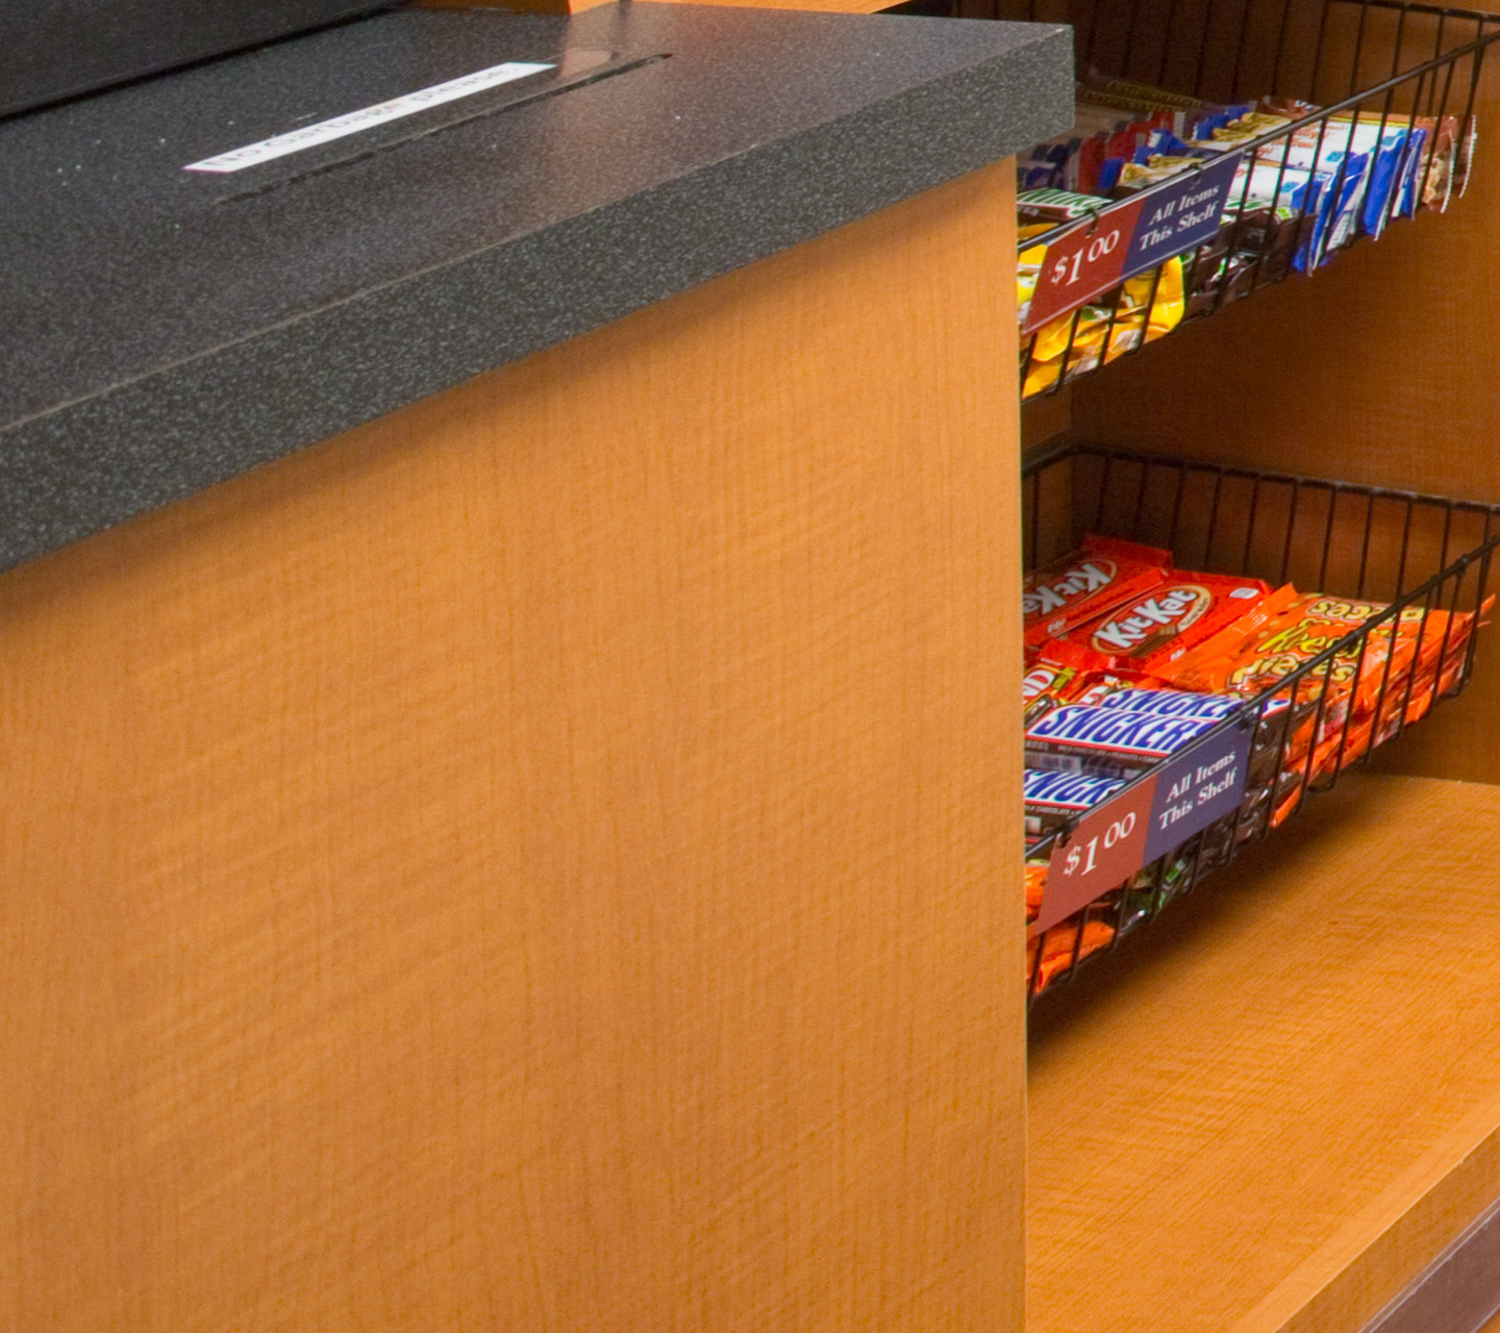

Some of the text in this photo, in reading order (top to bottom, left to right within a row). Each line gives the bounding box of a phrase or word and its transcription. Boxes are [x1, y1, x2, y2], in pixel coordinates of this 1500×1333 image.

[203, 150, 260, 167] No
[1139, 204, 1217, 252] This Shelf
[1150, 184, 1220, 224] All Items
[1159, 768, 1237, 831] This Shelf
[1166, 750, 1236, 803] All Items
